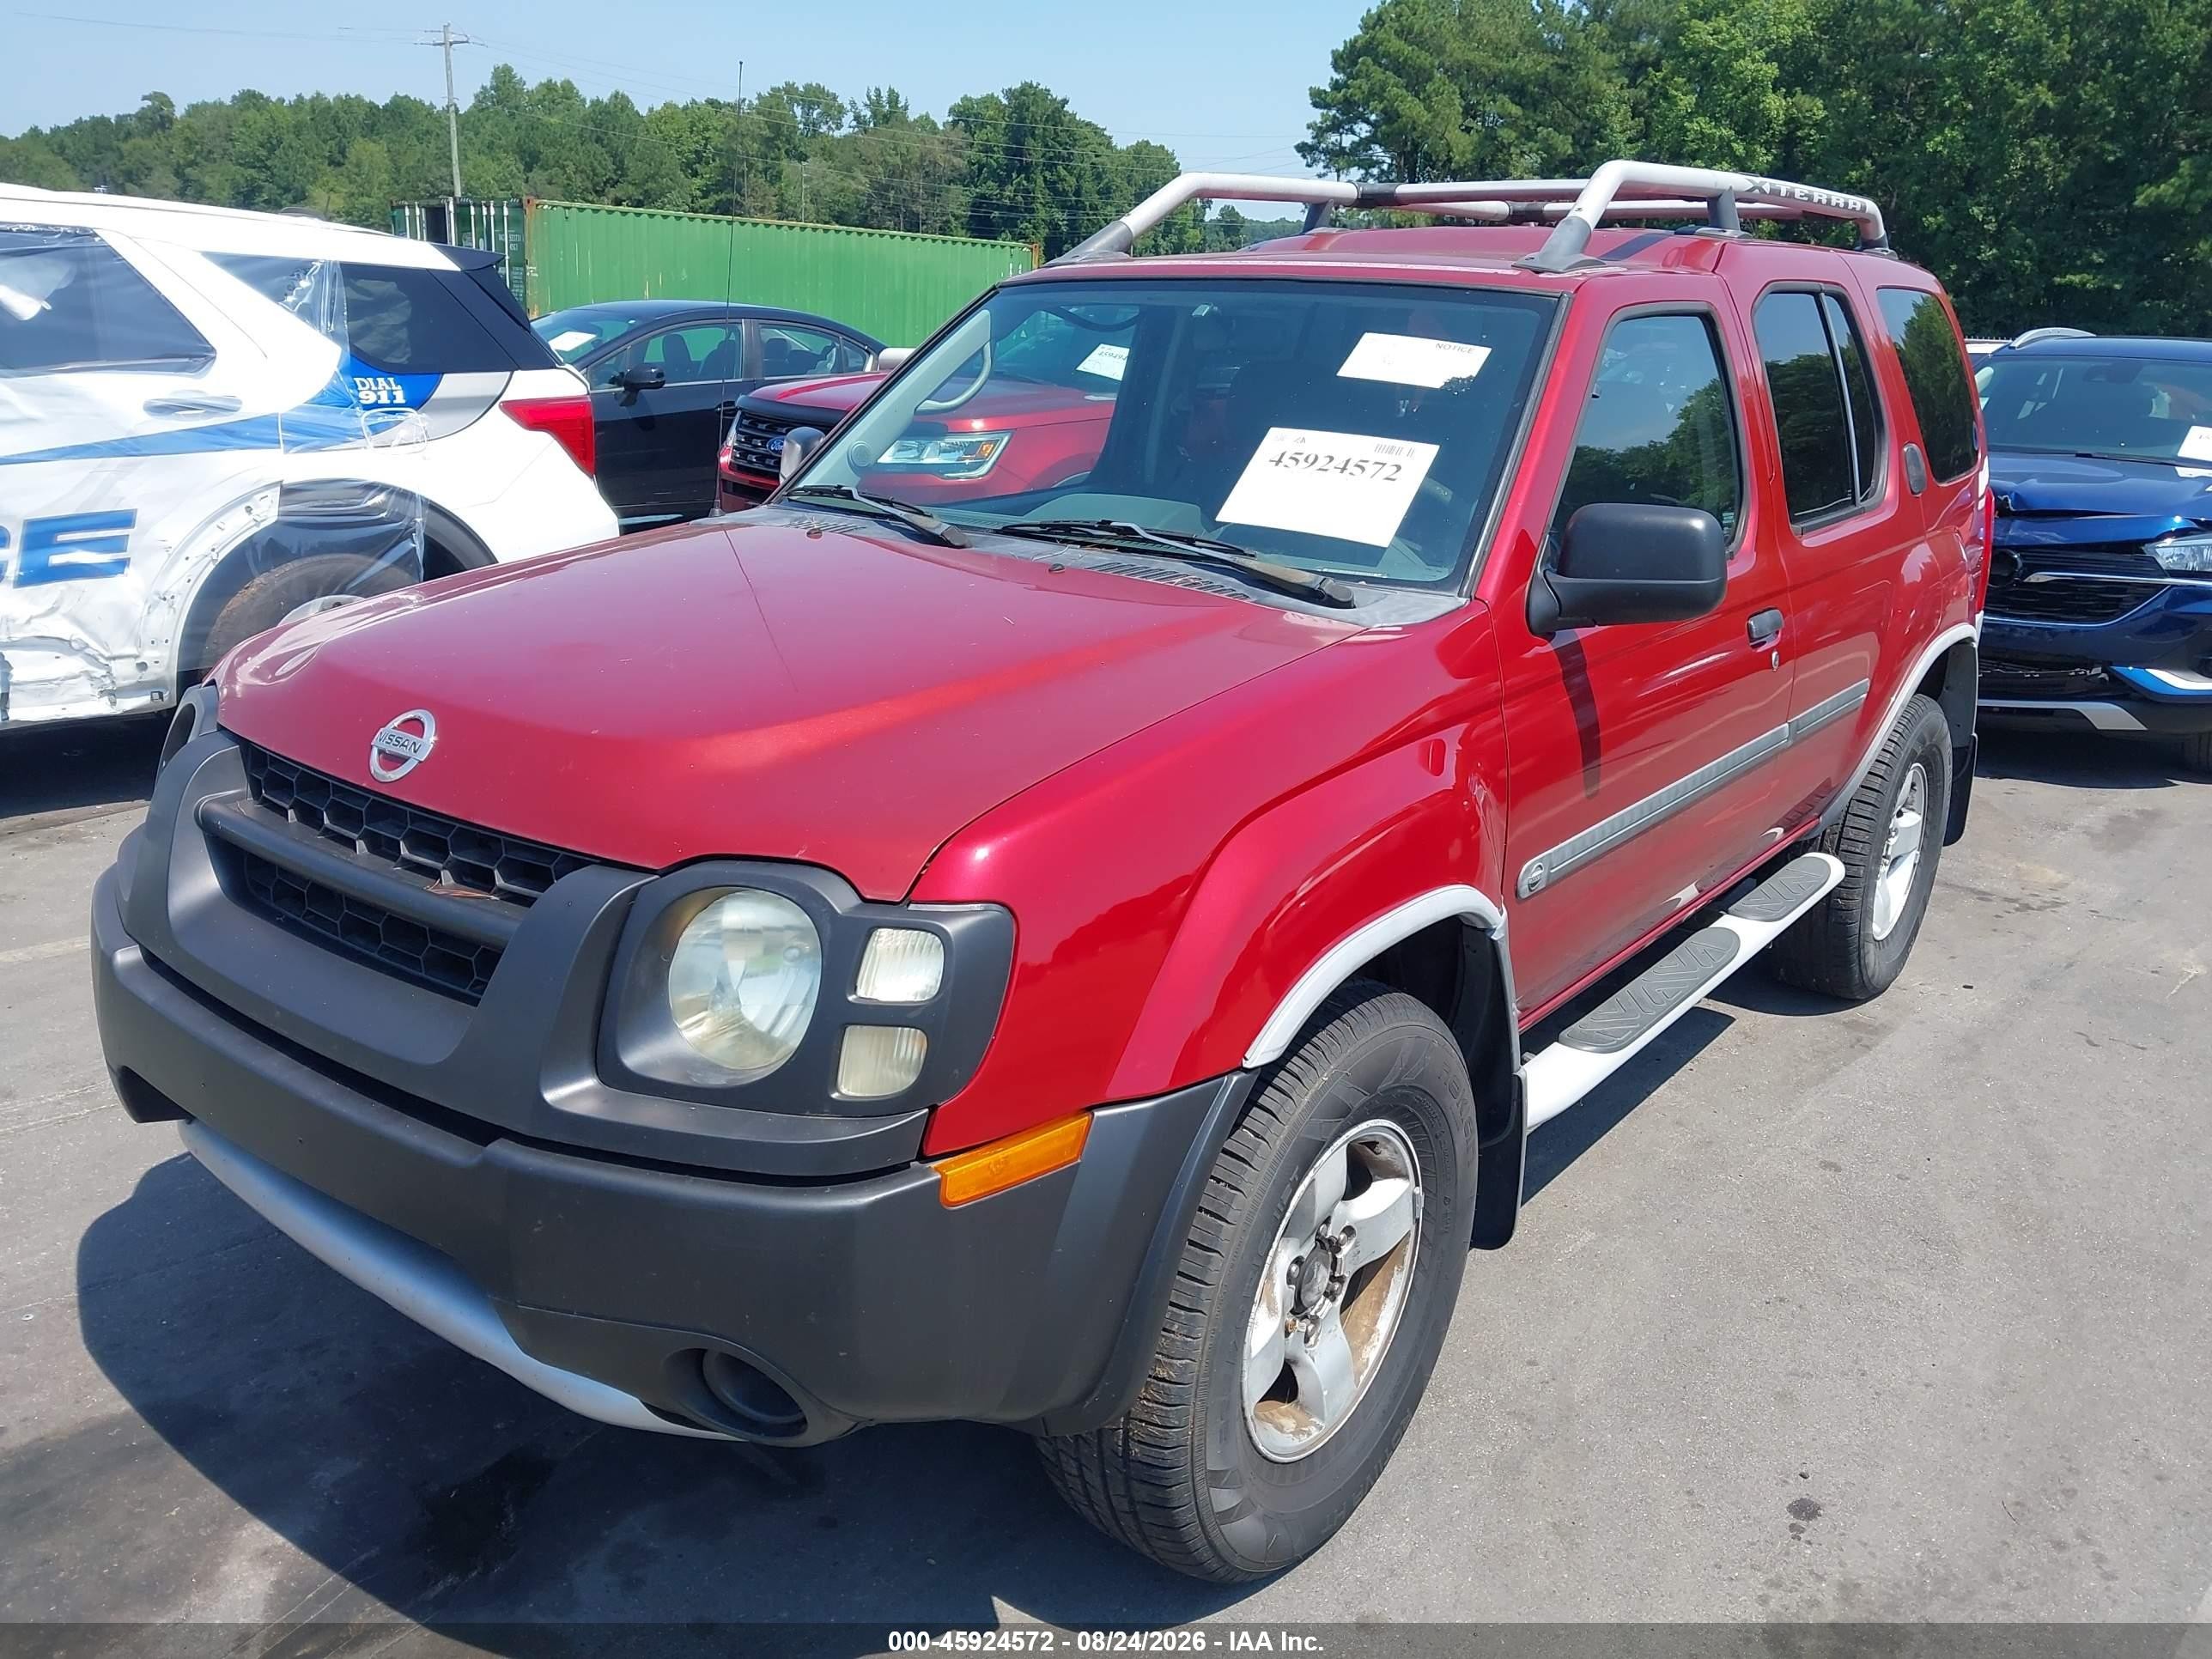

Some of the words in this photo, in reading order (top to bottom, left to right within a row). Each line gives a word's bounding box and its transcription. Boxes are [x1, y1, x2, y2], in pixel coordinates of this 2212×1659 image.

[1745, 178, 1862, 212] XTERRA
[1436, 343, 1476, 355] NOTICE
[353, 377, 403, 391] DIAL
[358, 390, 406, 404] 911
[1268, 450, 1402, 482] 45924572
[0, 508, 137, 589] E
[377, 731, 422, 754] NISSAN
